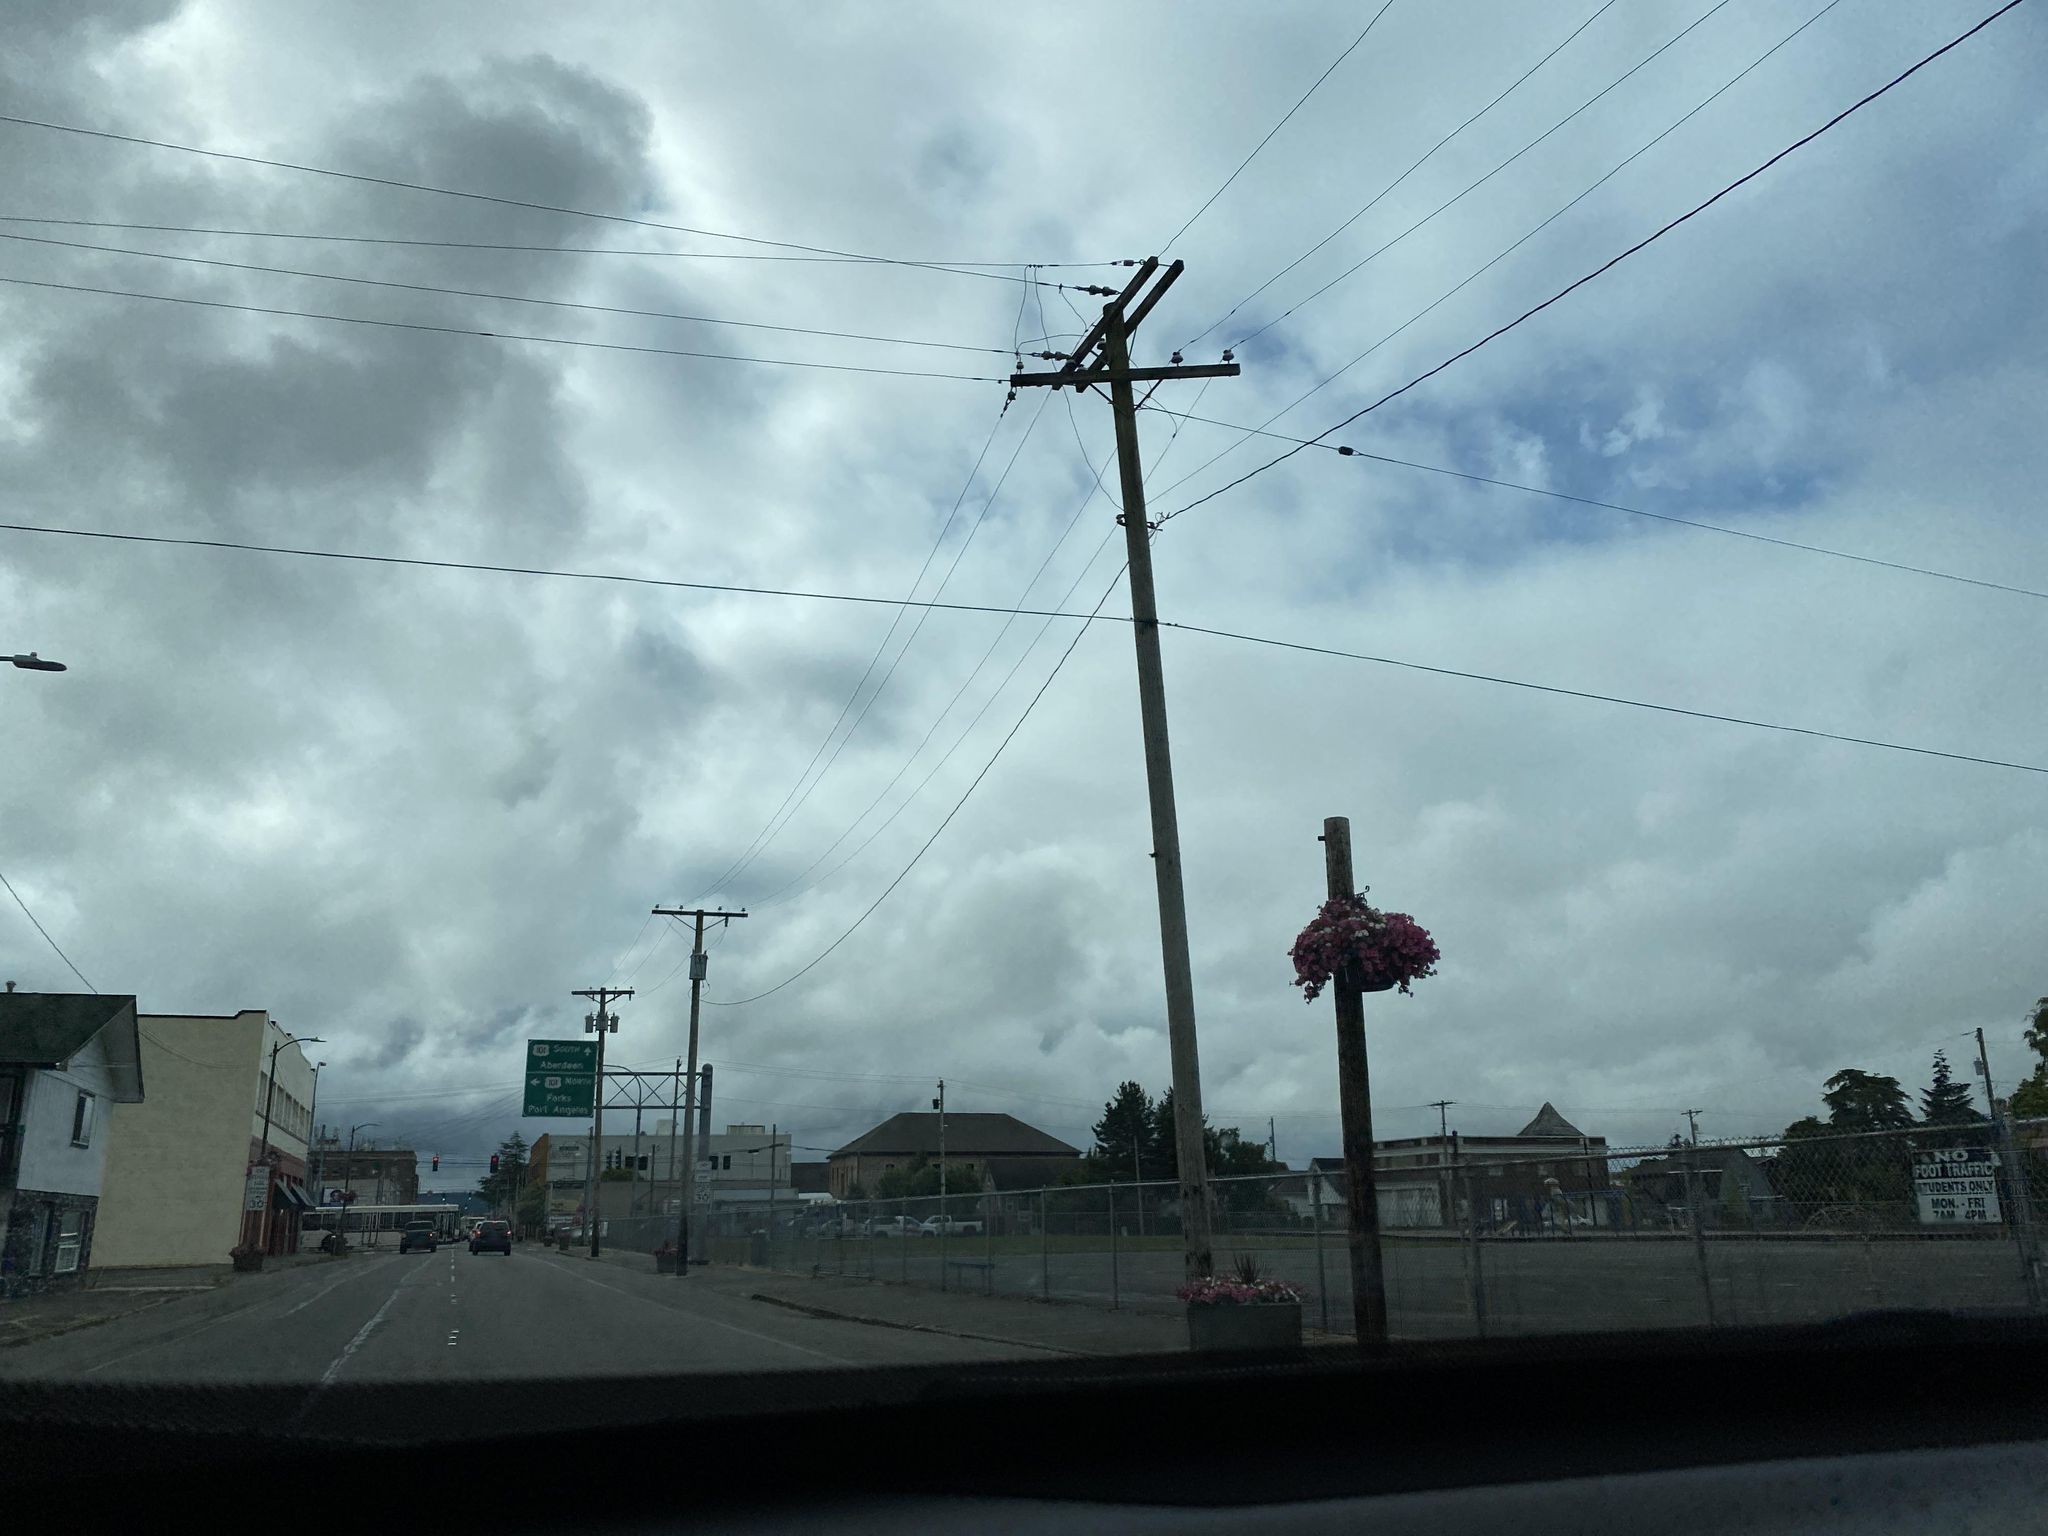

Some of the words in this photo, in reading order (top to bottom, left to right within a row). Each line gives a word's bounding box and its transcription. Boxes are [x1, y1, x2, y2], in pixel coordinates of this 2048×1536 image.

[540, 1061, 584, 1070] Aberdeen
[548, 1078, 559, 1086] 101
[546, 1093, 572, 1102] Forks
[528, 1104, 548, 1113] Port
[553, 1105, 588, 1115] Angeles
[1934, 1150, 1969, 1162] NO
[1914, 1164, 1942, 1178] FOOT
[1946, 1161, 1994, 1177] TRAFFIC
[1969, 1180, 1994, 1192] ONLY
[1931, 1198, 1959, 1209] MON.
[1967, 1198, 1985, 1208] FRI
[1965, 1209, 1987, 1220] 4PM
